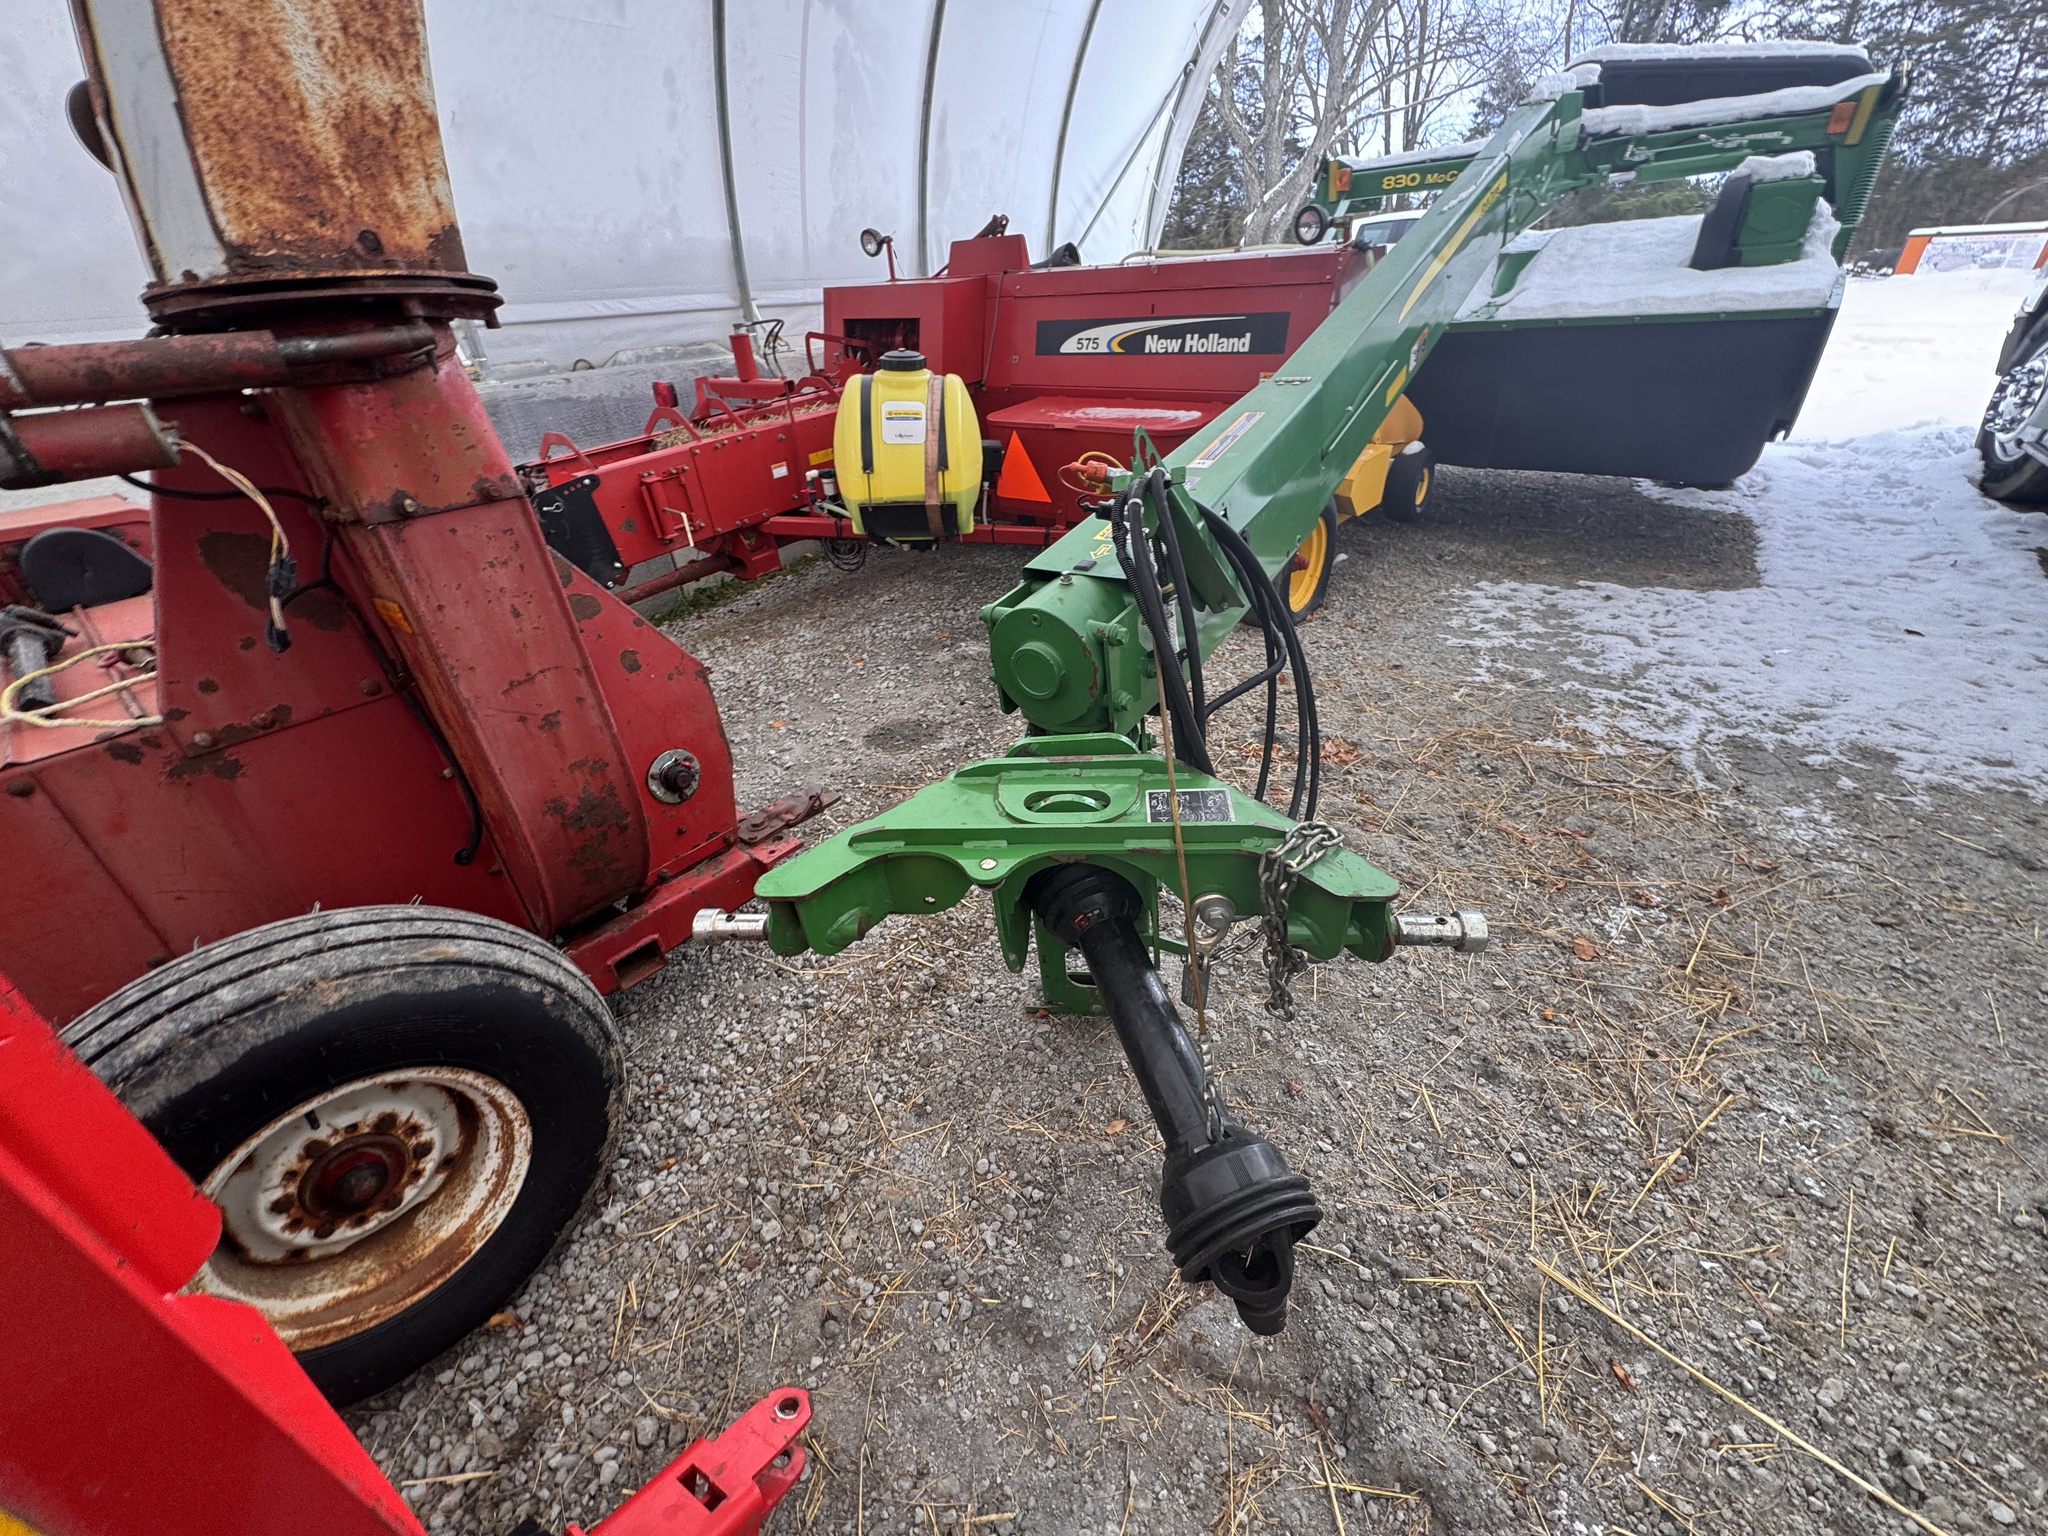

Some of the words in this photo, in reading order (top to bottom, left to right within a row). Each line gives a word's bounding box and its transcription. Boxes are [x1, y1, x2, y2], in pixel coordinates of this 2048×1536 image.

[1381, 172, 1420, 189] 830
[1424, 170, 1460, 184] MoC
[1076, 337, 1100, 350] 575
[1144, 334, 1182, 353] New
[1184, 332, 1251, 352] Holland
